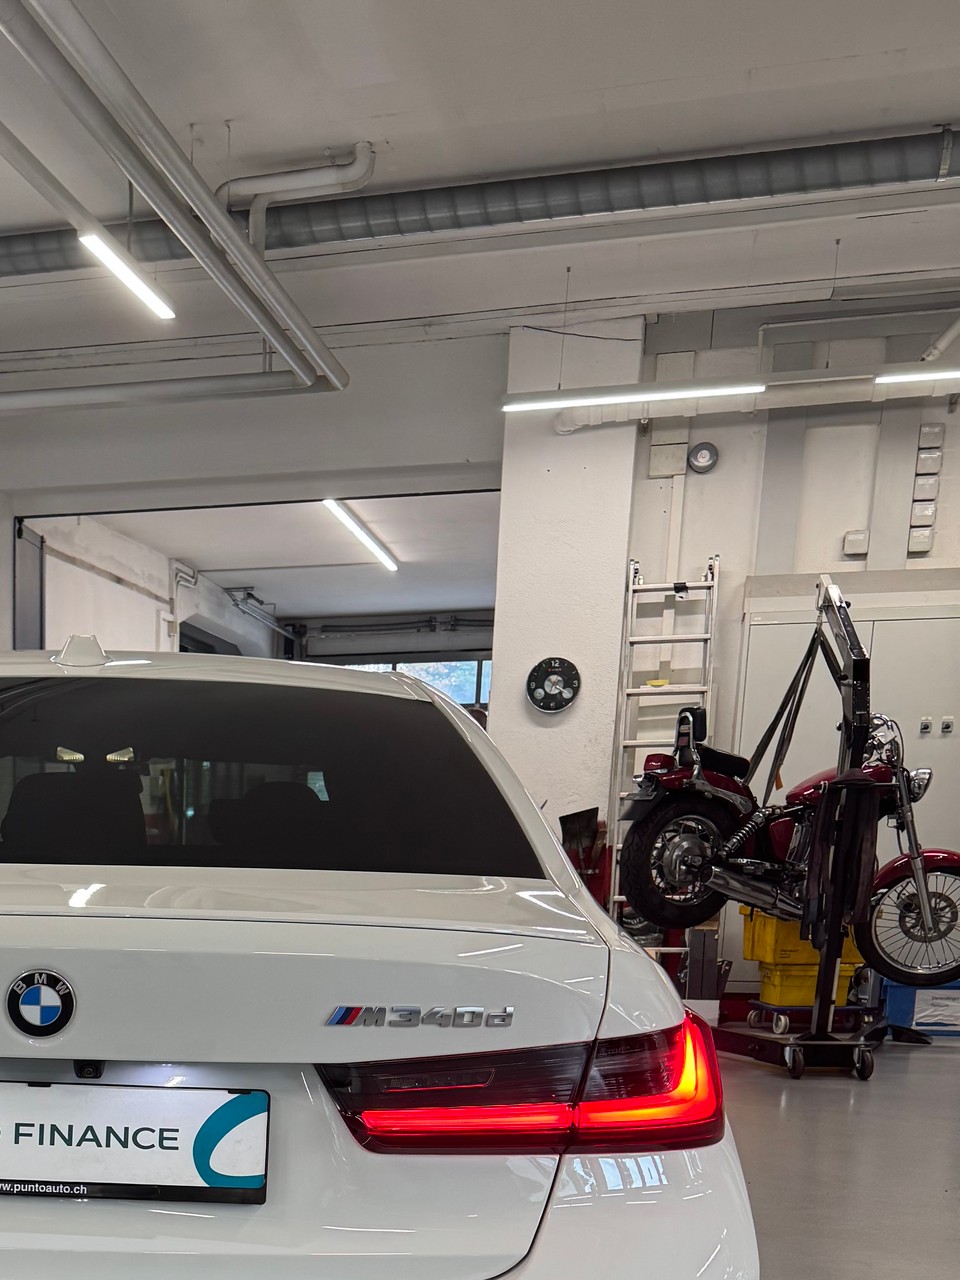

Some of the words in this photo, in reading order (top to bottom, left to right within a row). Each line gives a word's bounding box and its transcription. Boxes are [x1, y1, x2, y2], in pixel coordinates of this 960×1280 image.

[13, 973, 69, 996] BMW
[324, 1005, 515, 1028] M340d
[14, 1122, 180, 1151] FINANCE
